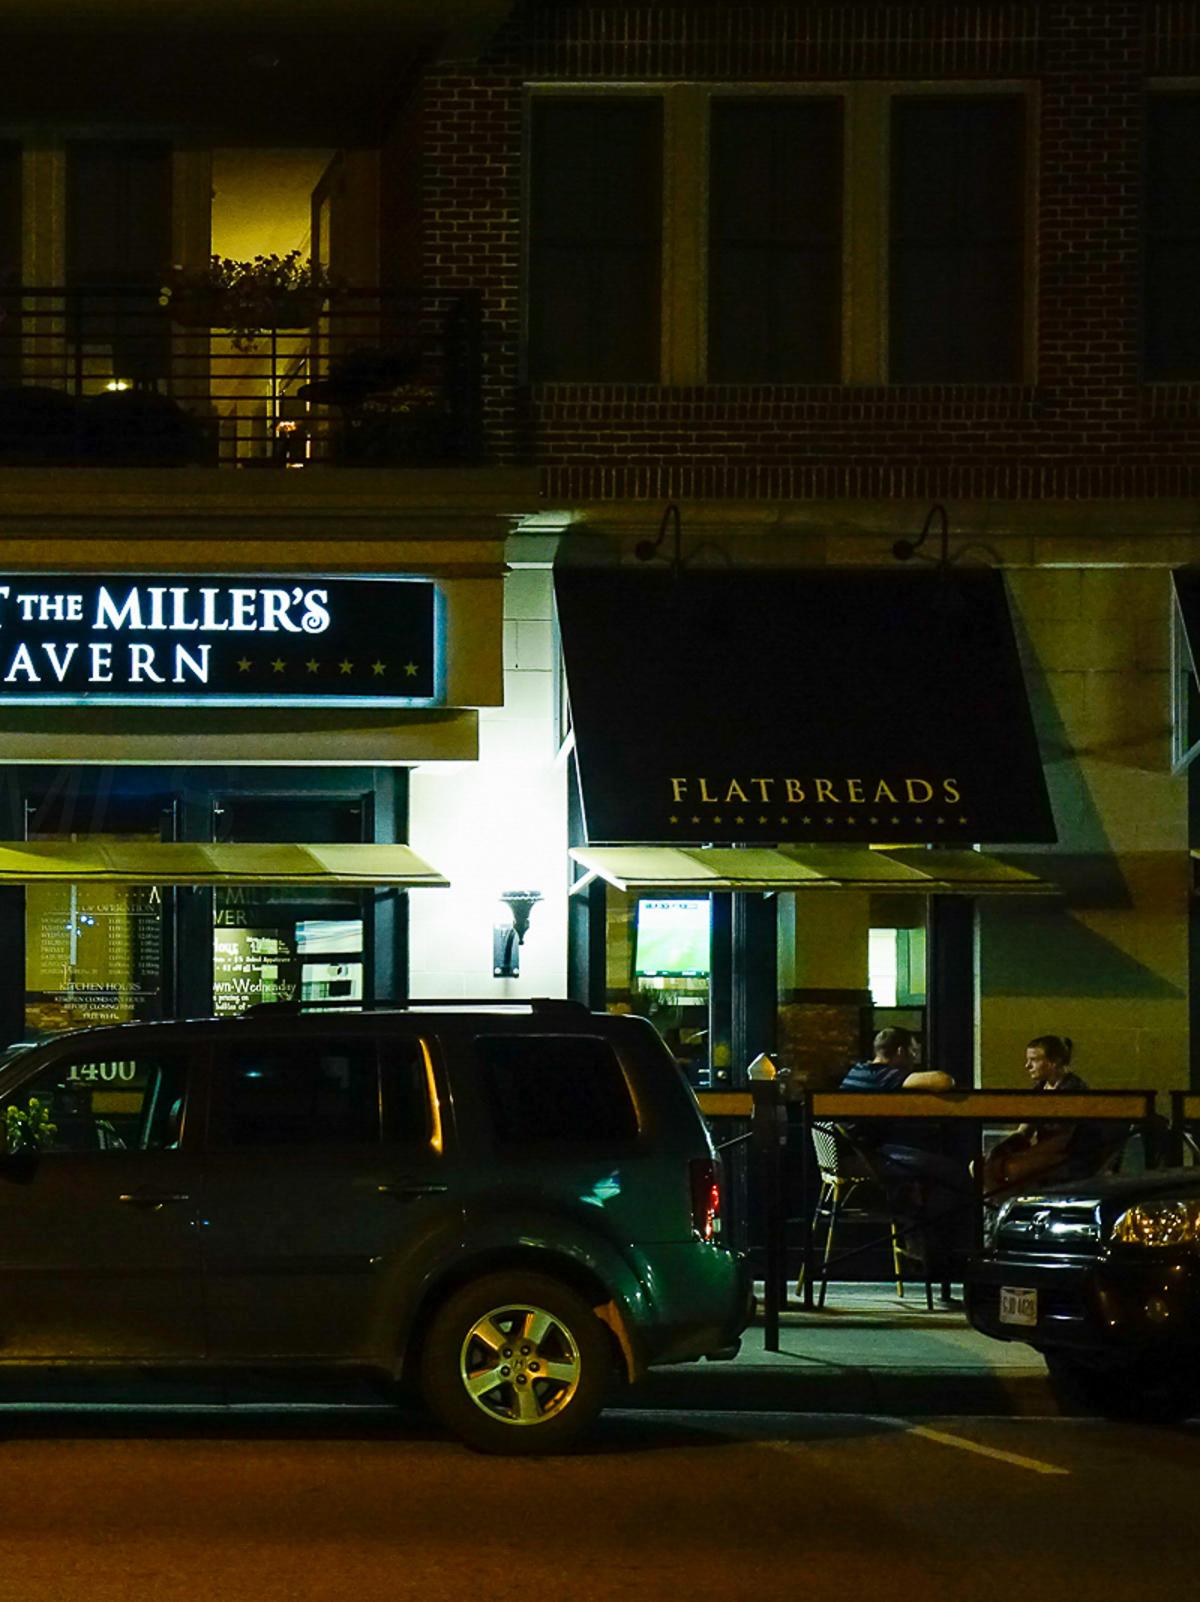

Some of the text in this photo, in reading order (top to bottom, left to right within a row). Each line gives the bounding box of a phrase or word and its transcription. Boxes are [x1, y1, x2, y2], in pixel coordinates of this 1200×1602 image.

[17, 594, 84, 622] THE
[93, 585, 331, 634] MILLER'S
[669, 778, 961, 804] FLATBREADS
[59, 982, 104, 991] KITCHEN
[66, 1060, 136, 1081] 1400
